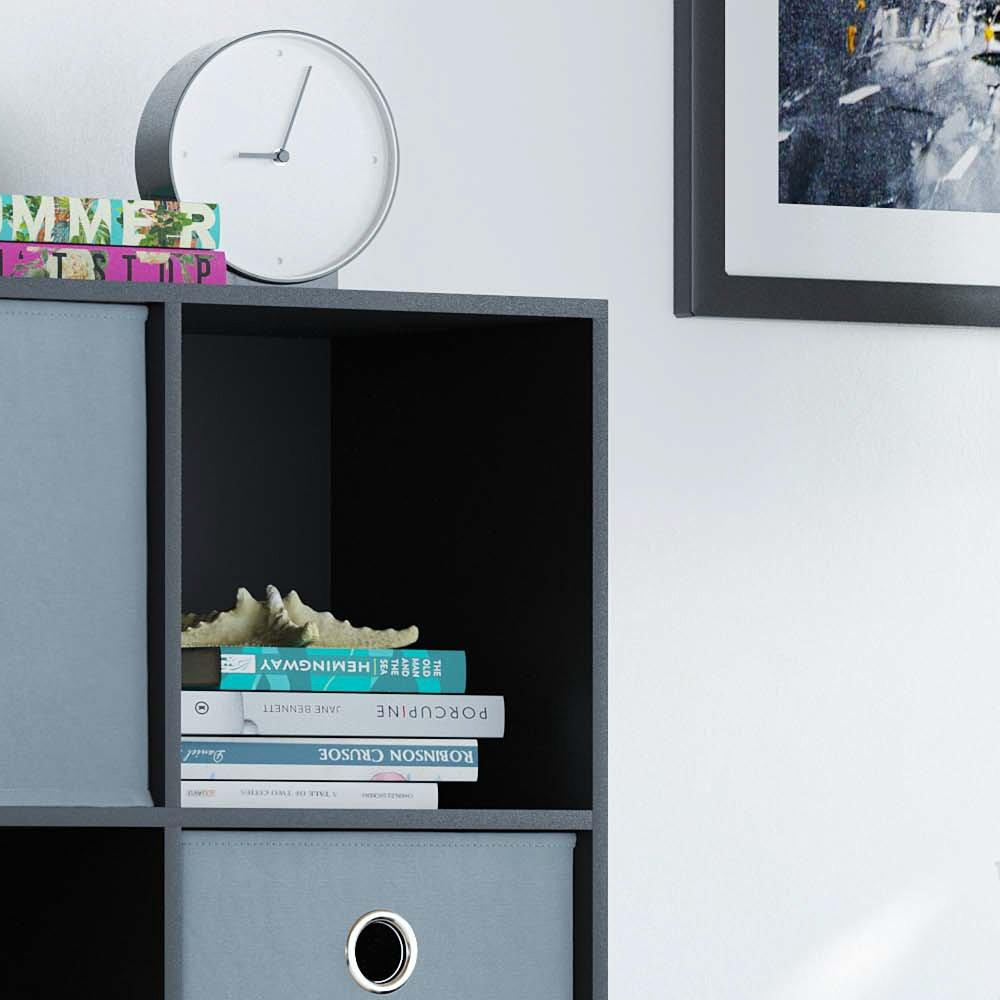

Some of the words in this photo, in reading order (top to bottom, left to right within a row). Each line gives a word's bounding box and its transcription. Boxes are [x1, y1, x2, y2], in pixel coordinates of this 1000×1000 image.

[260, 658, 370, 673] HEMINGWAY
[380, 659, 389, 676] SEA
[391, 658, 399, 676] THE
[401, 658, 410, 677] AND
[412, 658, 420, 678] MAN
[423, 658, 431, 677] OLD
[433, 659, 442, 677] THE
[263, 703, 312, 713] BENNETT
[314, 704, 341, 714] JANE
[376, 704, 488, 720] PORCUPINE
[183, 750, 227, 763] Daniel
[318, 748, 384, 763] CRUSOE
[390, 748, 473, 764] ROBINSON
